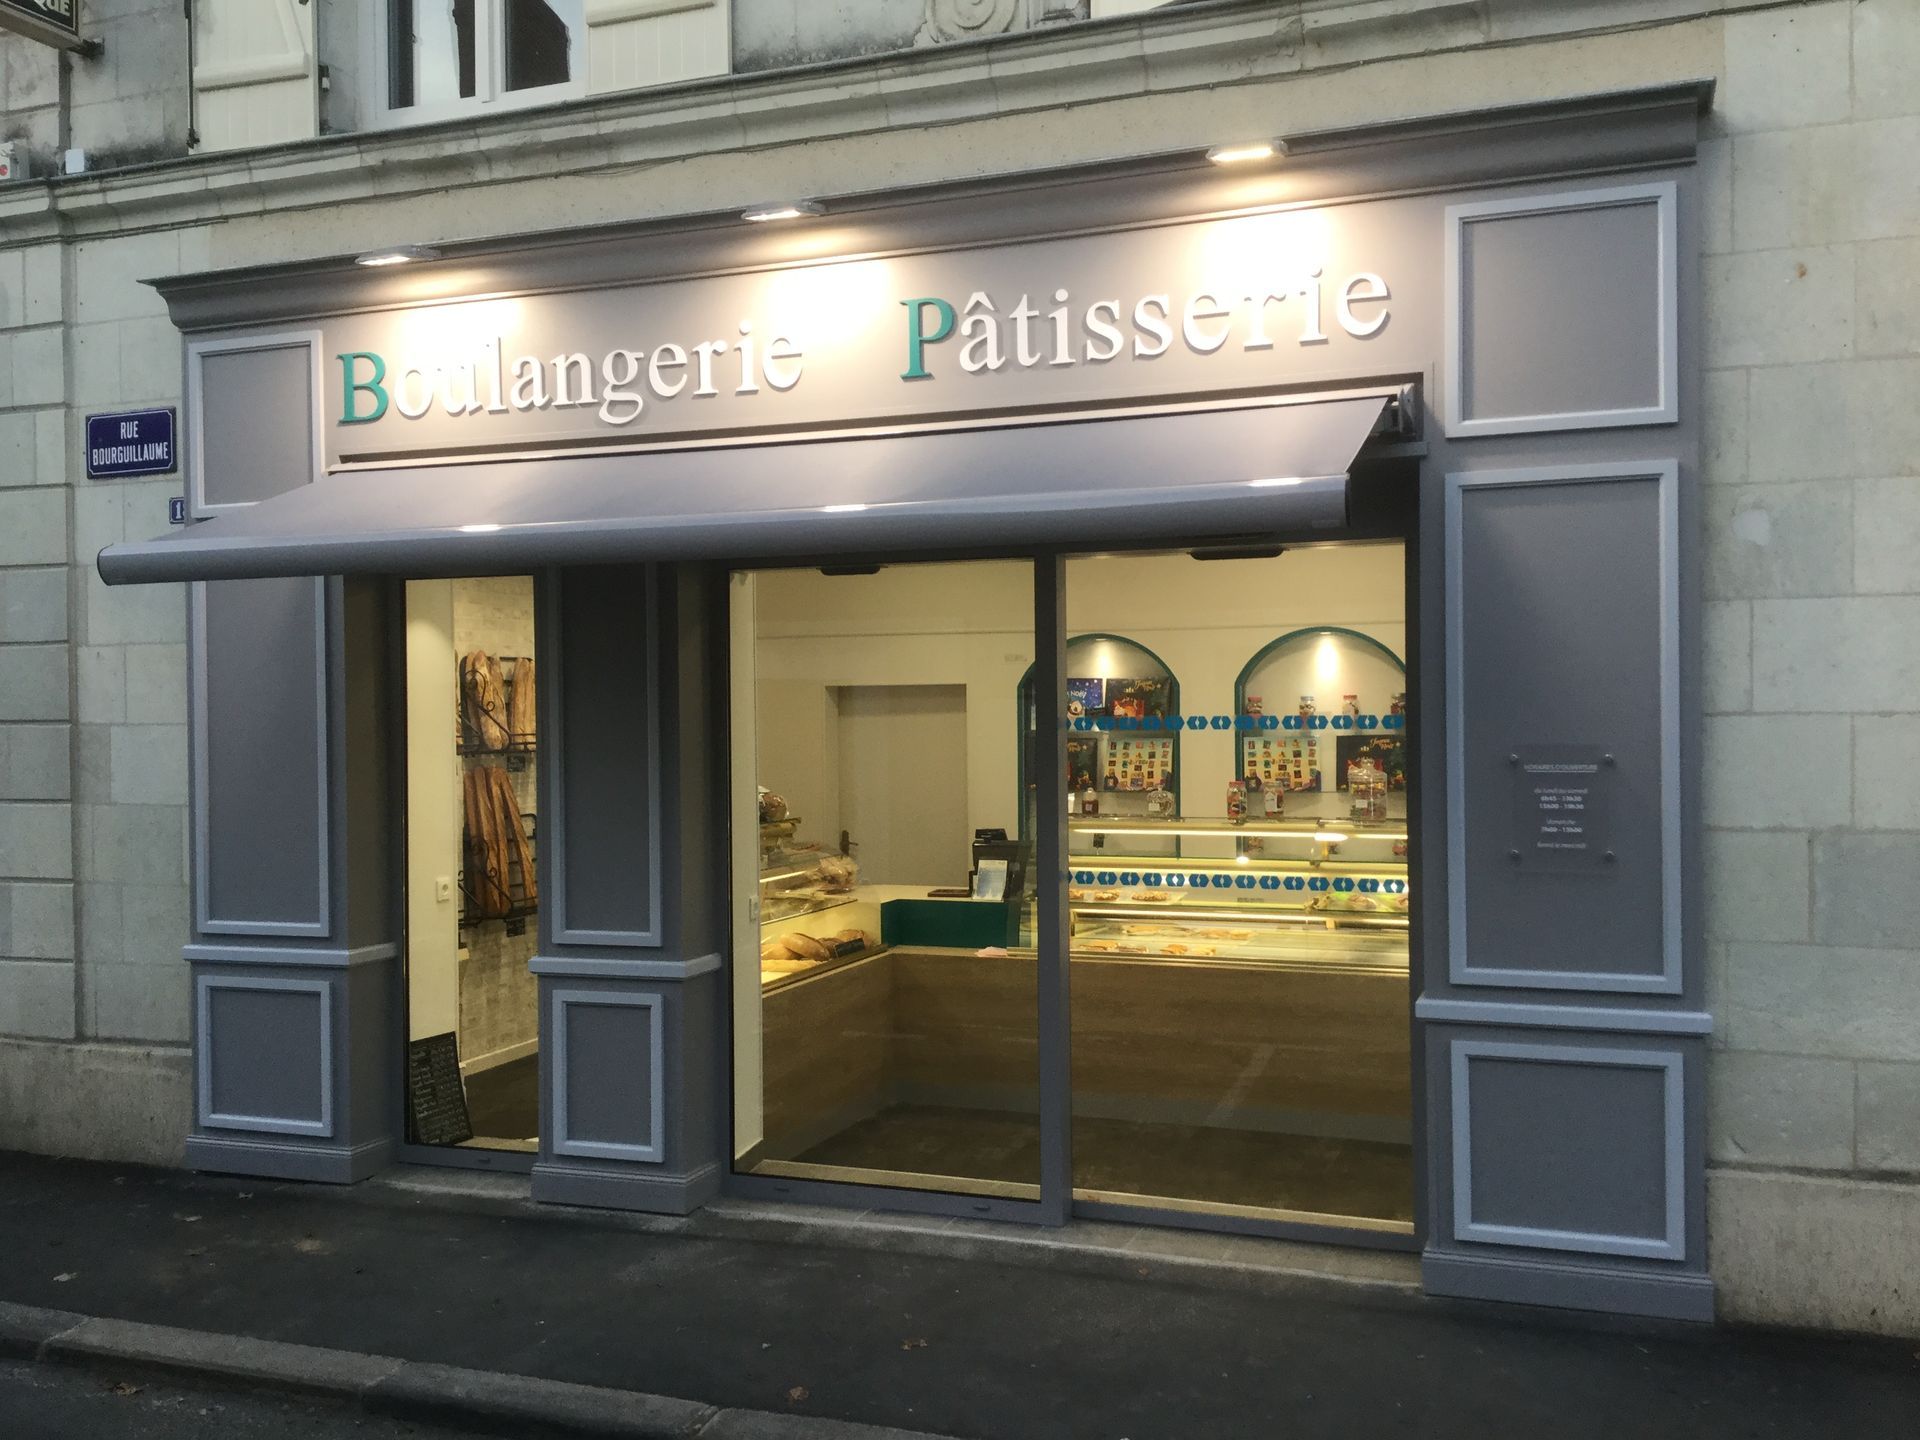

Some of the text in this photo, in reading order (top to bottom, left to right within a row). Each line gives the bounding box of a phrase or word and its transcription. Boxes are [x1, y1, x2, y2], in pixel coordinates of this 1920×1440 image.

[34, 0, 71, 16] UE
[336, 267, 1391, 425] Boulangerie Pâtisserie
[120, 421, 139, 440] RUE
[92, 442, 169, 466] BOURGUILLAUME
